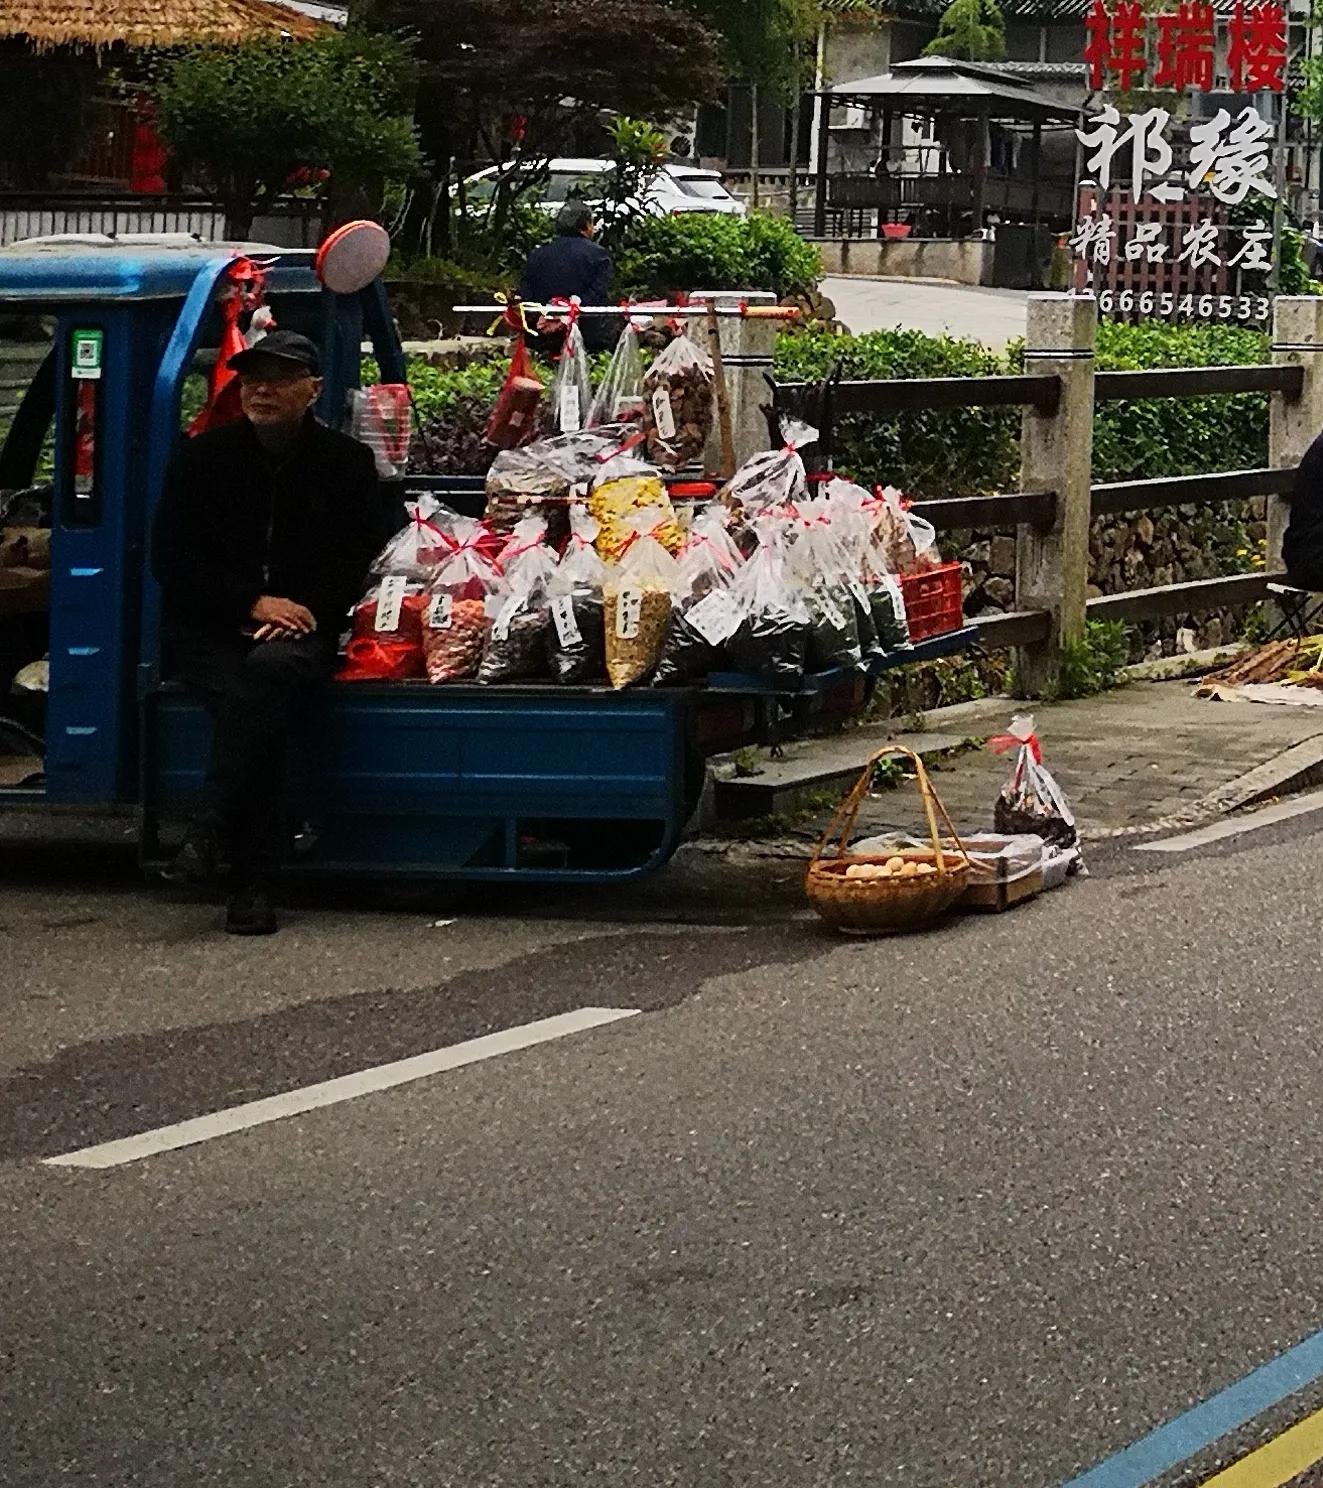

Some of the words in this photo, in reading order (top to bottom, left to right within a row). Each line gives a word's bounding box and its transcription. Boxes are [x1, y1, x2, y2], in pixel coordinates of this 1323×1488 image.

[1081, 0, 1288, 94] 祥瑞楼
[1075, 103, 1279, 205] 祁缘
[1068, 213, 1274, 272] 精品农庄
